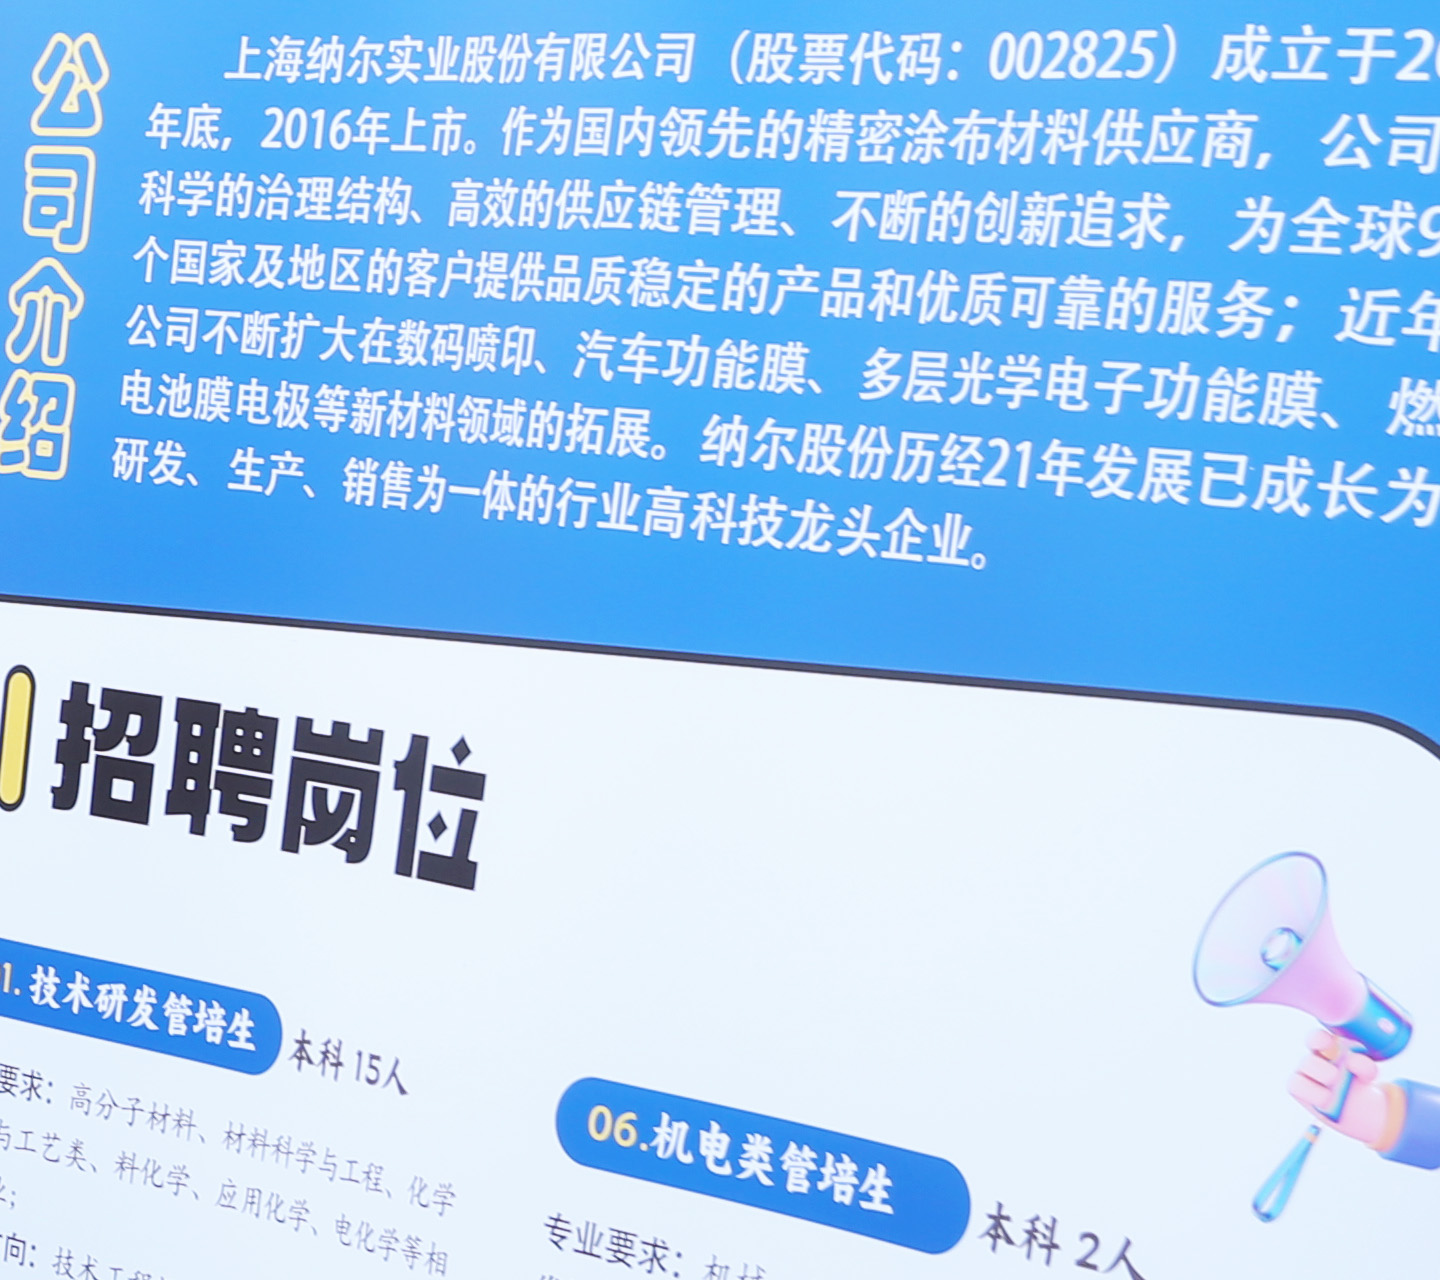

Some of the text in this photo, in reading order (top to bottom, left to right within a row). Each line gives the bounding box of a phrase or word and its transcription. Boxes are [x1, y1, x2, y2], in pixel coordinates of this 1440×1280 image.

[51, 680, 486, 892] 招聘岗位
[28, 964, 257, 1053] 技术研发管培生
